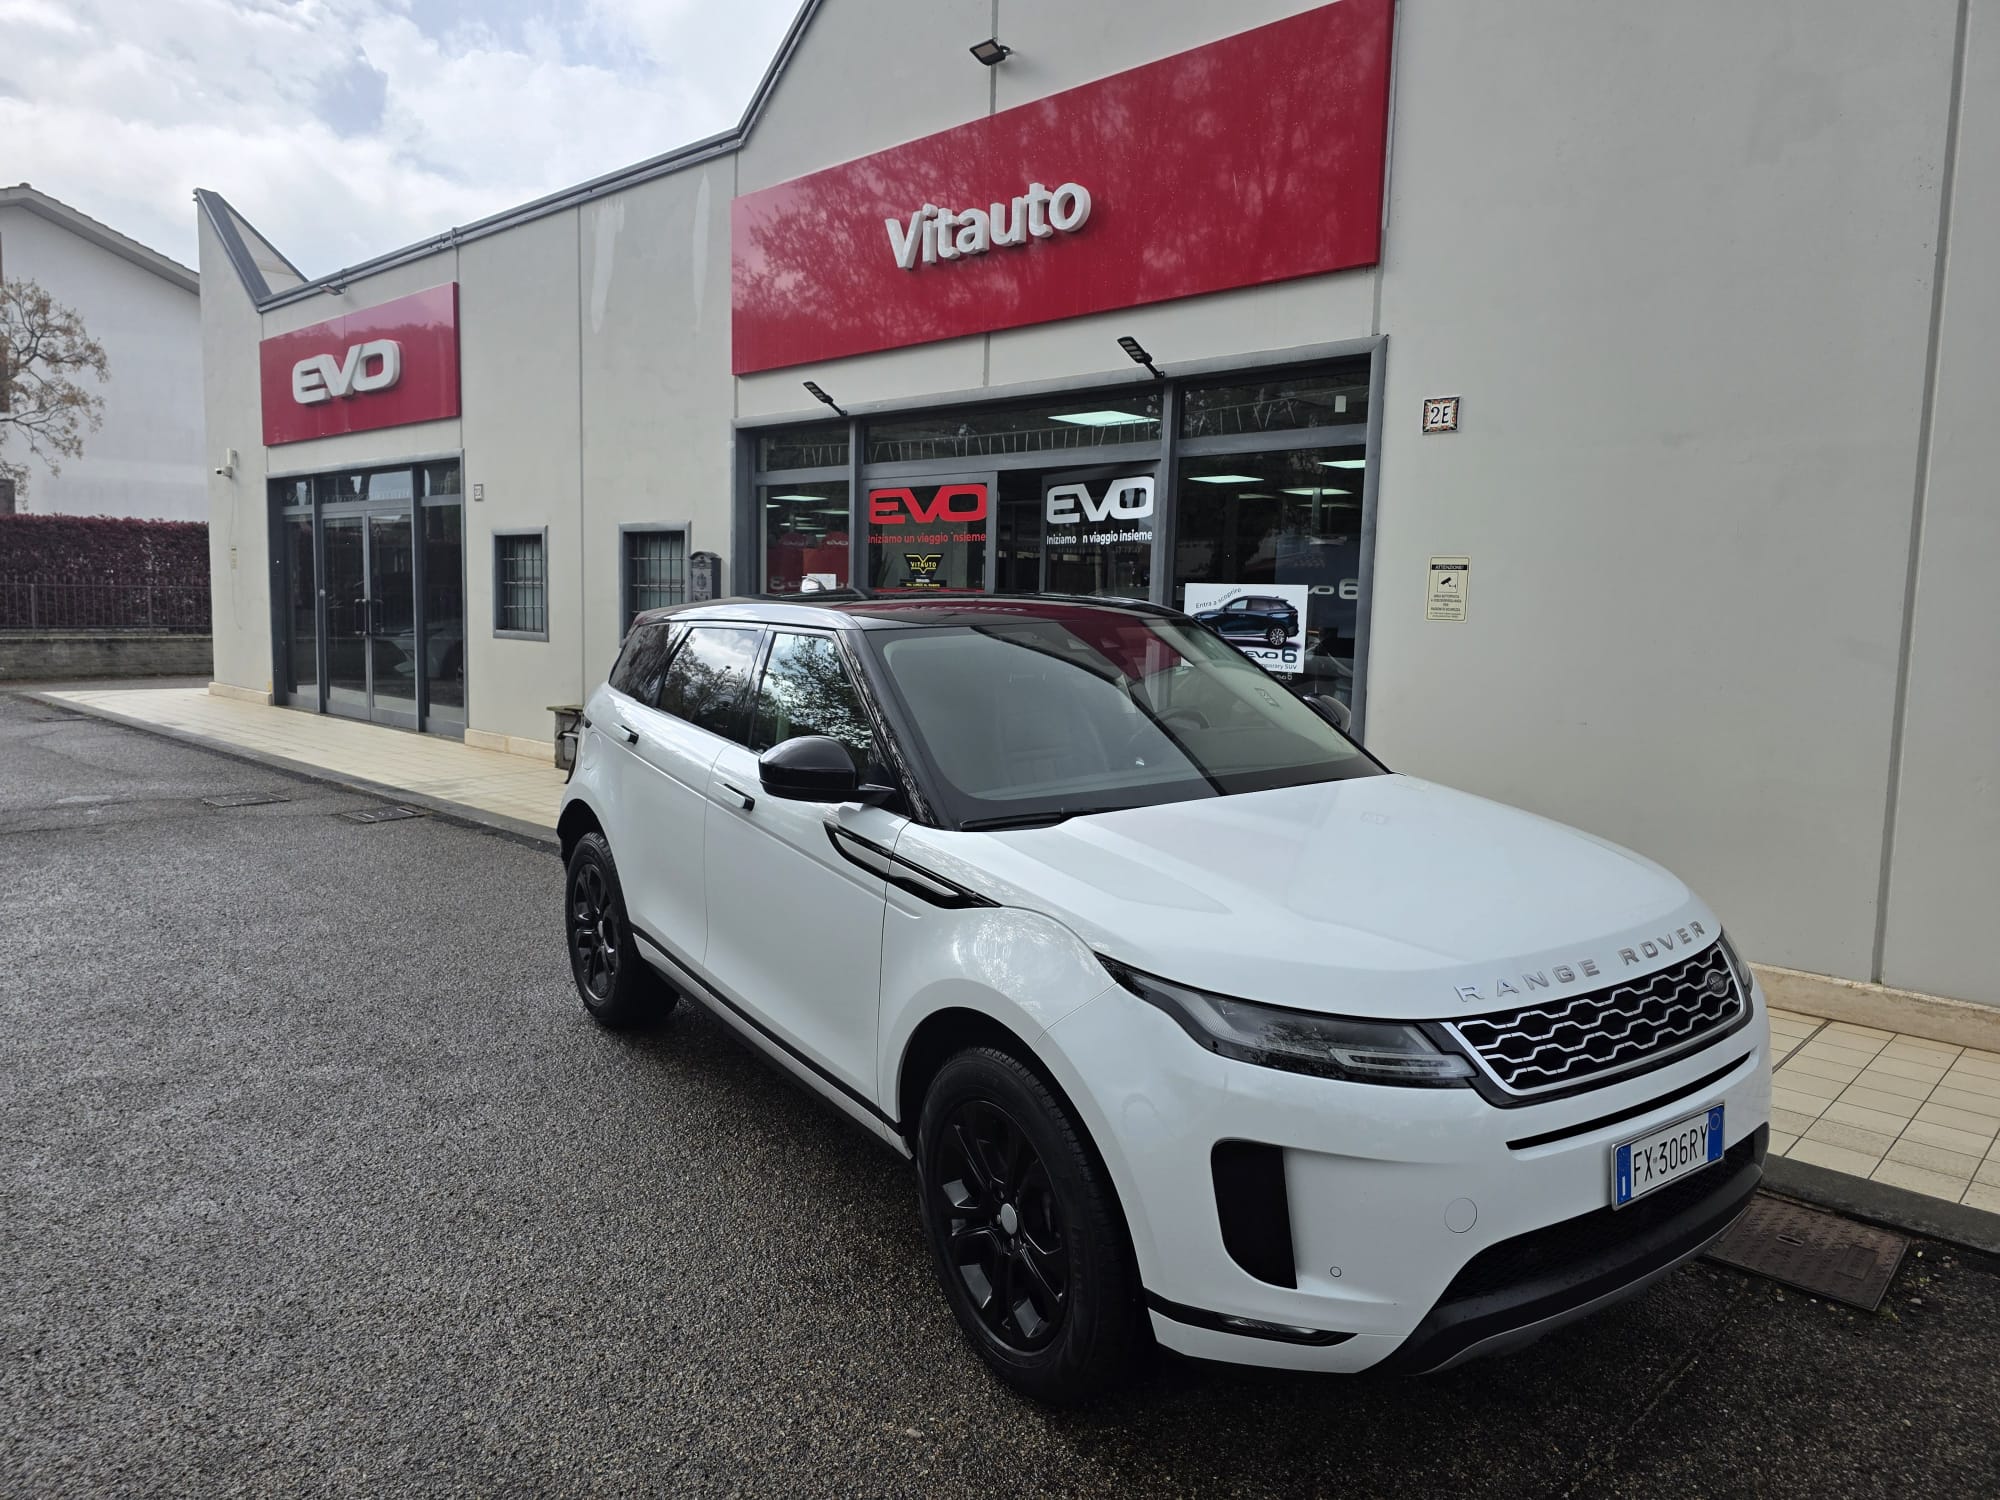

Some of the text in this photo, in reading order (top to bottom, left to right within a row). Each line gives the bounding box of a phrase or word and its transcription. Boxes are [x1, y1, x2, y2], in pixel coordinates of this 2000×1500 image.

[885, 182, 1092, 270] Vitauto
[292, 339, 401, 404] EVO
[1431, 405, 1451, 425] 2E
[869, 484, 987, 524] EVO
[1046, 476, 1154, 524] EVO
[868, 530, 986, 545] Iniziamo un viaggio nsieme
[1046, 533, 1077, 545] Iniziamo
[1089, 530, 1118, 545] viaggio
[1119, 529, 1153, 542] insieme
[1195, 601, 1212, 609] Entra
[1282, 647, 1297, 664] 6
[1453, 920, 1706, 1003] RANGE ROVER
